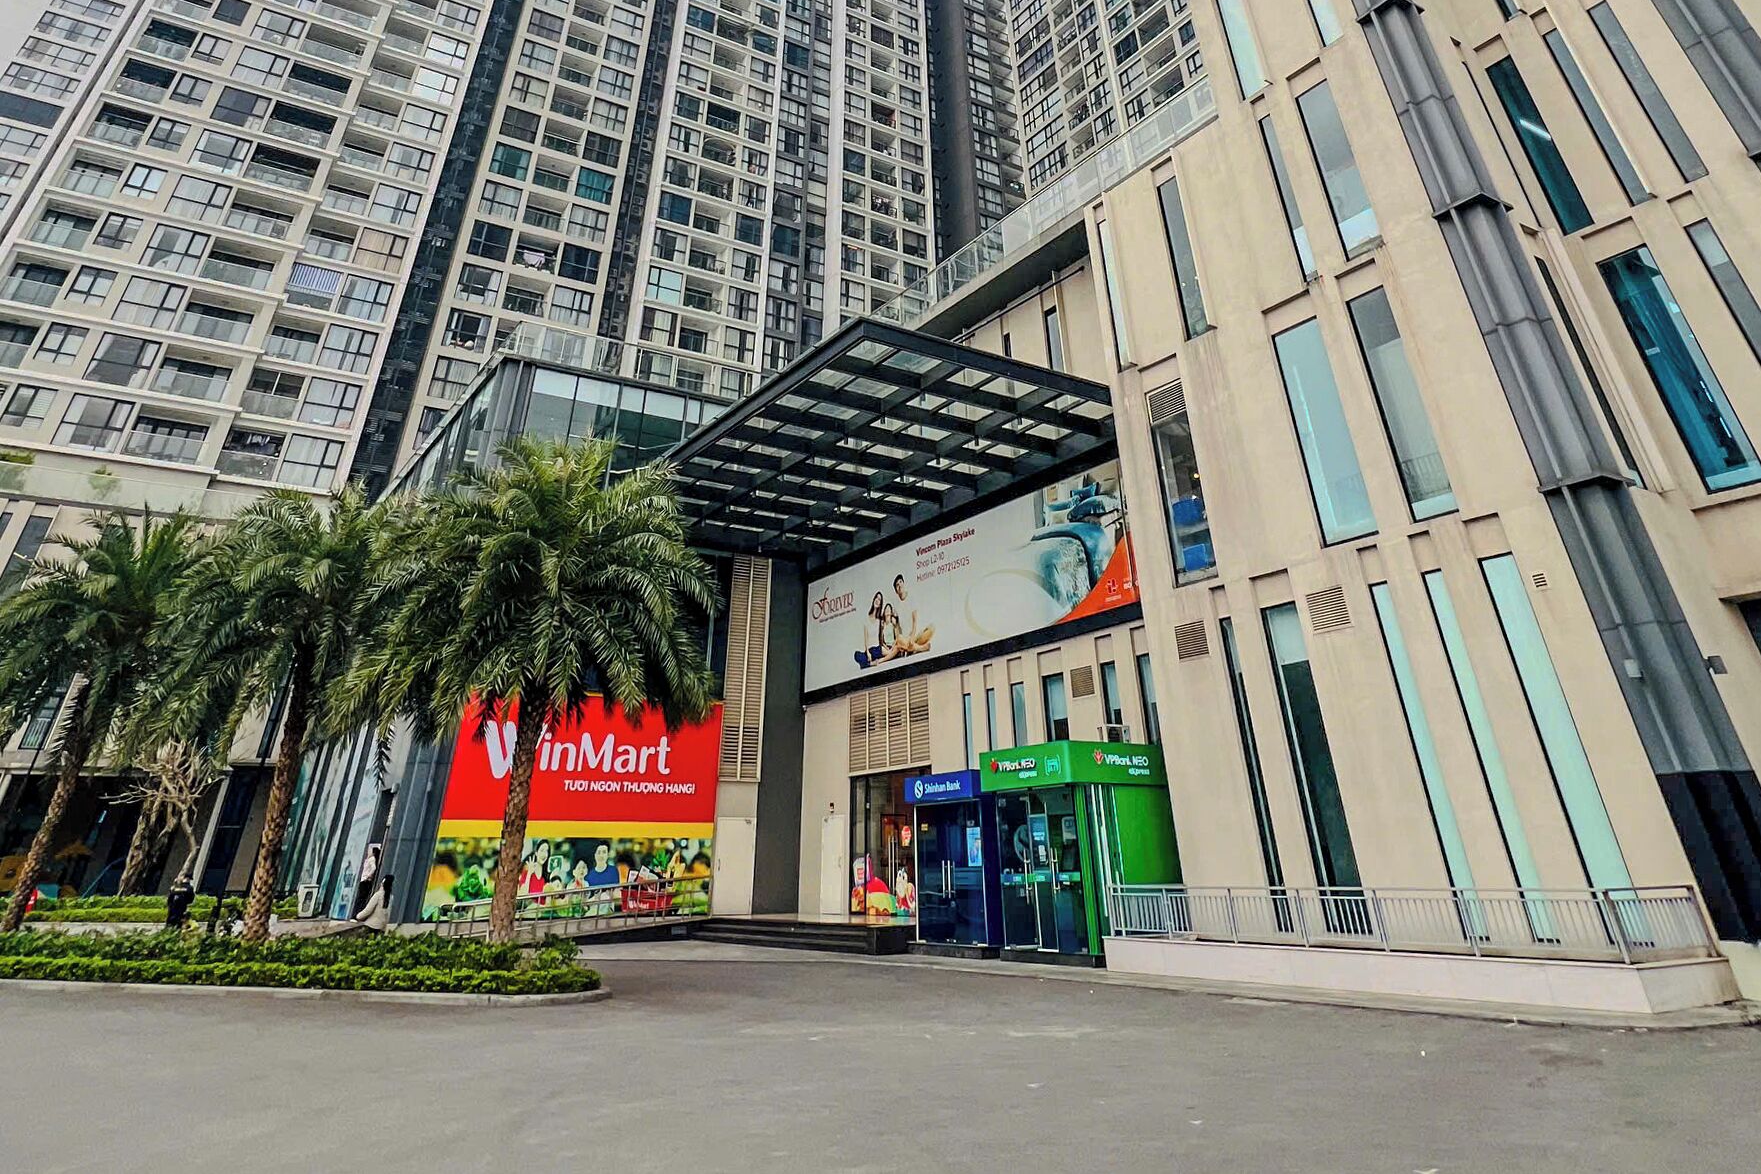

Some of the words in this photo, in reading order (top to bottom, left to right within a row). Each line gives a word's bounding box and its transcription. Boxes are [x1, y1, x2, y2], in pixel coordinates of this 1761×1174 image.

[1021, 758, 1036, 769] NEO
[1132, 756, 1149, 766] NEO
[590, 781, 621, 792] NGON
[924, 782, 946, 794] Shinhan
[946, 780, 961, 791] Bank
